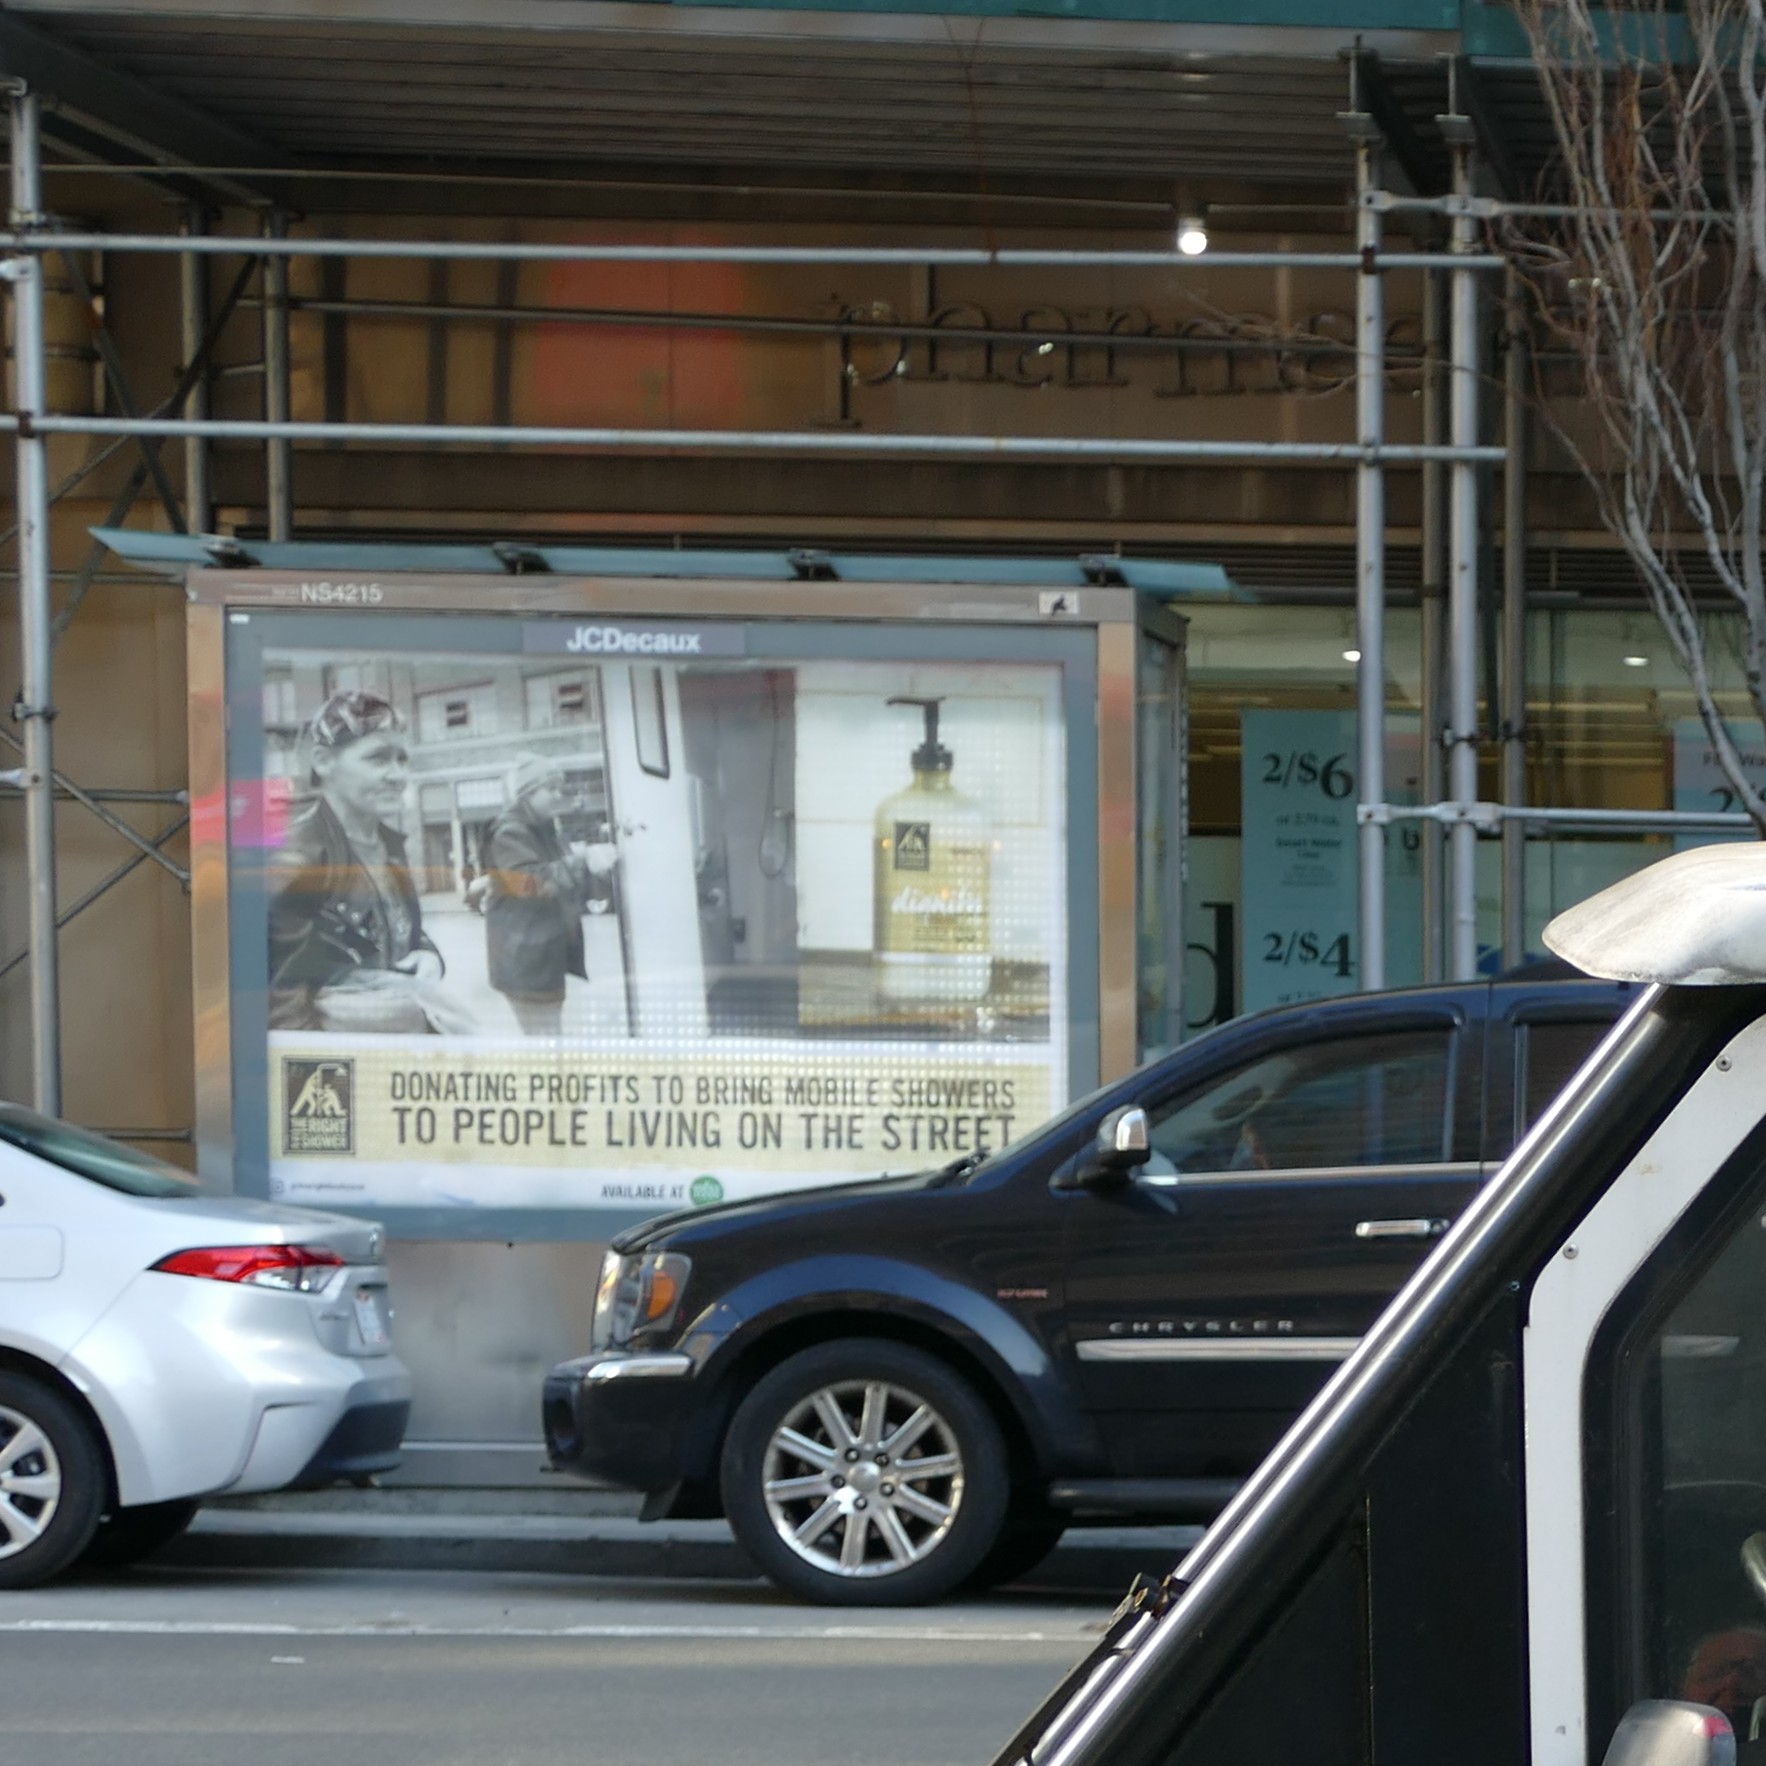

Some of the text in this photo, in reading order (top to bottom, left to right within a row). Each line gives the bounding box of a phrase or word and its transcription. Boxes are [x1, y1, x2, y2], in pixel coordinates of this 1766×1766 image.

[300, 581, 384, 604] NS4215
[566, 625, 701, 653] JCDecaux
[1261, 750, 1355, 799] 2/$6
[1261, 930, 1356, 979] 2/$4
[390, 1070, 1016, 1110] DONATING PROFITS TO BRING MOBILE SHOWERS
[392, 1105, 1016, 1152] TO PEOPLE LIVING ON THE STREET
[601, 1186, 665, 1200] AVAILABLE
[670, 1186, 684, 1199] AT
[1108, 1319, 1295, 1333] CHRYSLER
